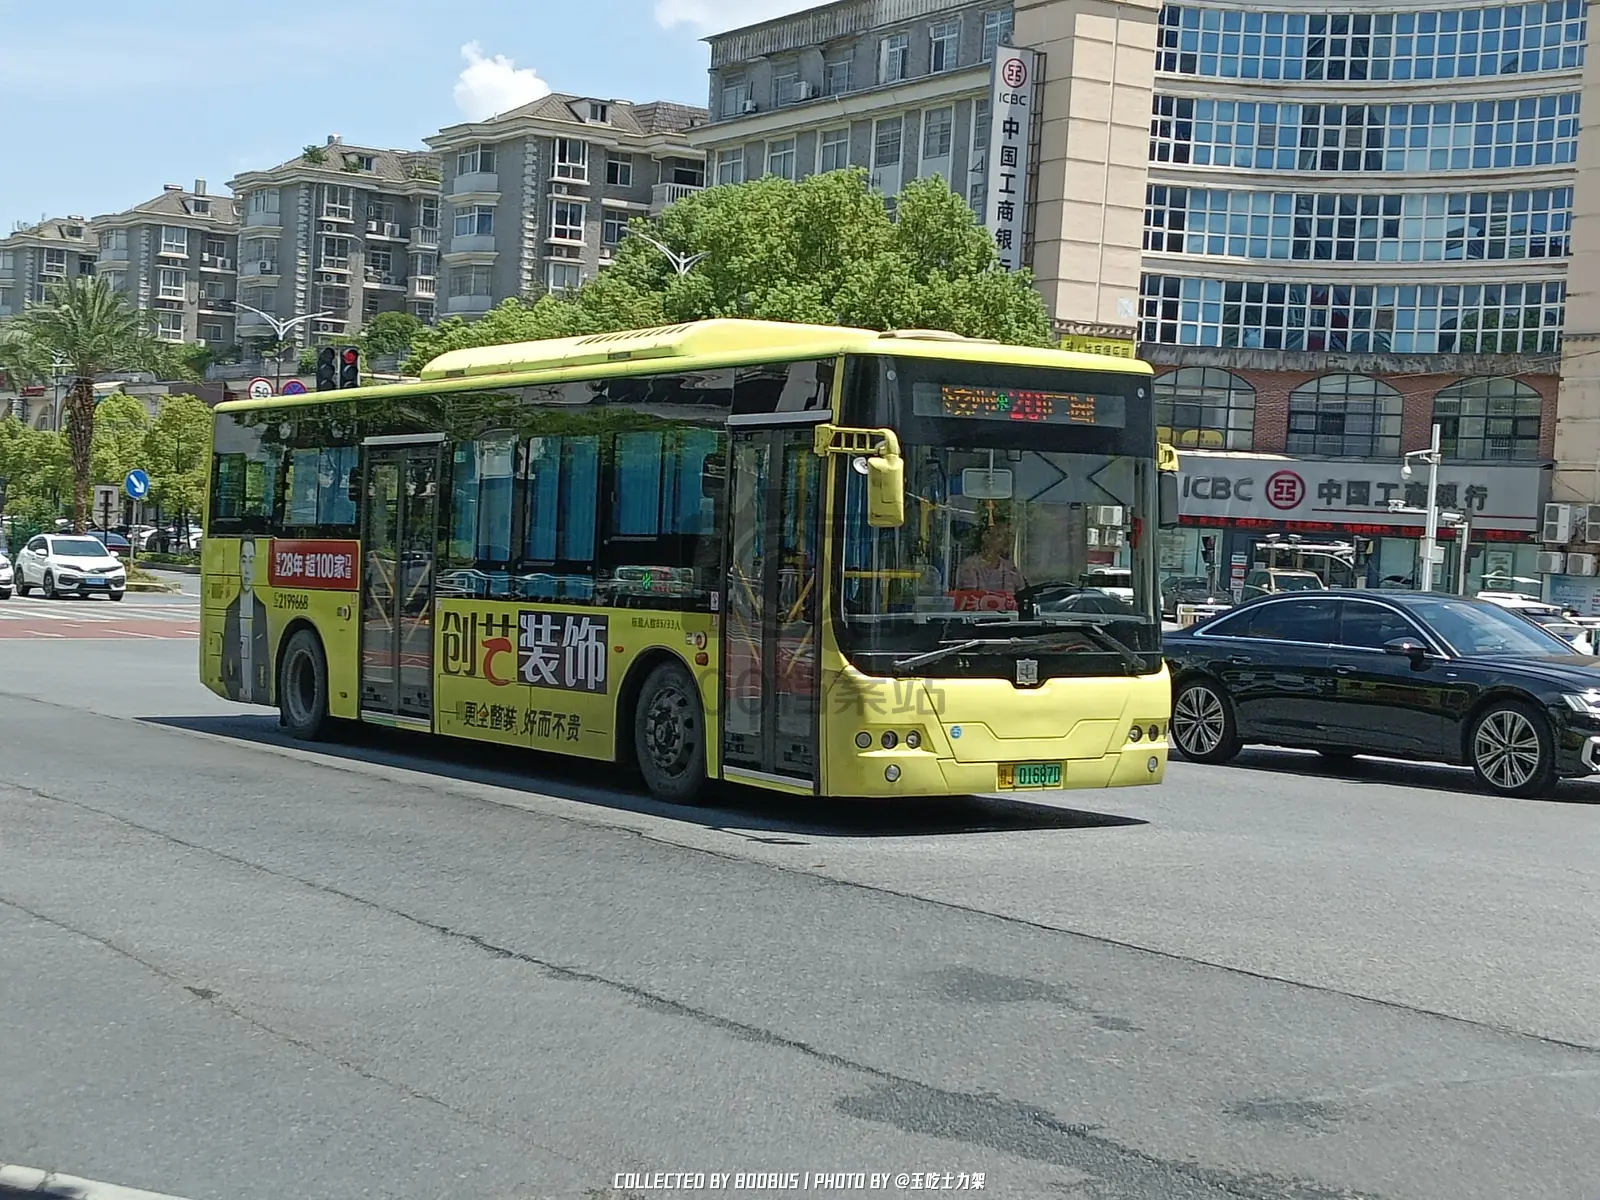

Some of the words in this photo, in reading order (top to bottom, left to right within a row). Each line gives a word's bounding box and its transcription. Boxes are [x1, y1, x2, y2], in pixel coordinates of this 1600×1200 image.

[998, 92, 1028, 106] ICBC
[255, 386, 269, 398] 50
[1183, 475, 1254, 501] ICBC
[1318, 479, 1488, 511] 中国工商银行
[442, 611, 607, 690] 创艺装饰
